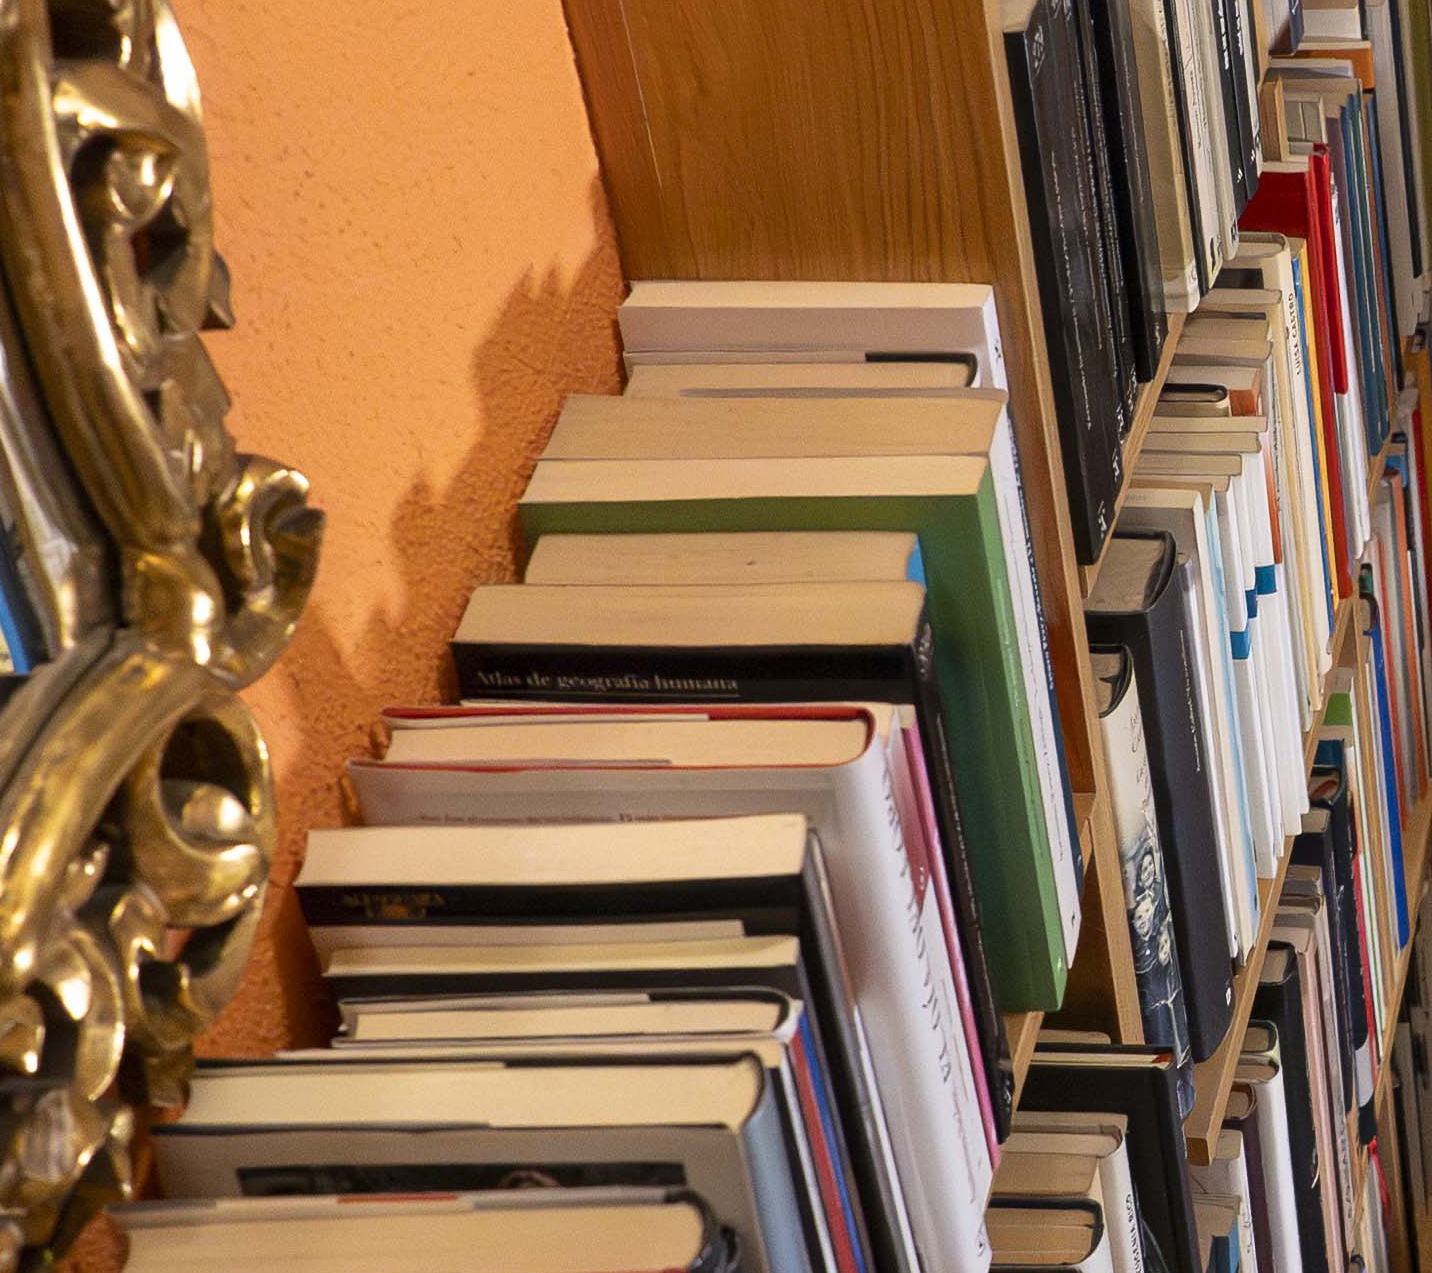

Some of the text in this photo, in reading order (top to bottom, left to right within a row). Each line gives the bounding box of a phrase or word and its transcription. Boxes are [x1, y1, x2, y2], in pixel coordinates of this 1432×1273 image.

[1288, 293, 1302, 375] LUISA CASTRO
[477, 671, 739, 693] Atlas de geografía humana
[1125, 1193, 1136, 1222] RICO
